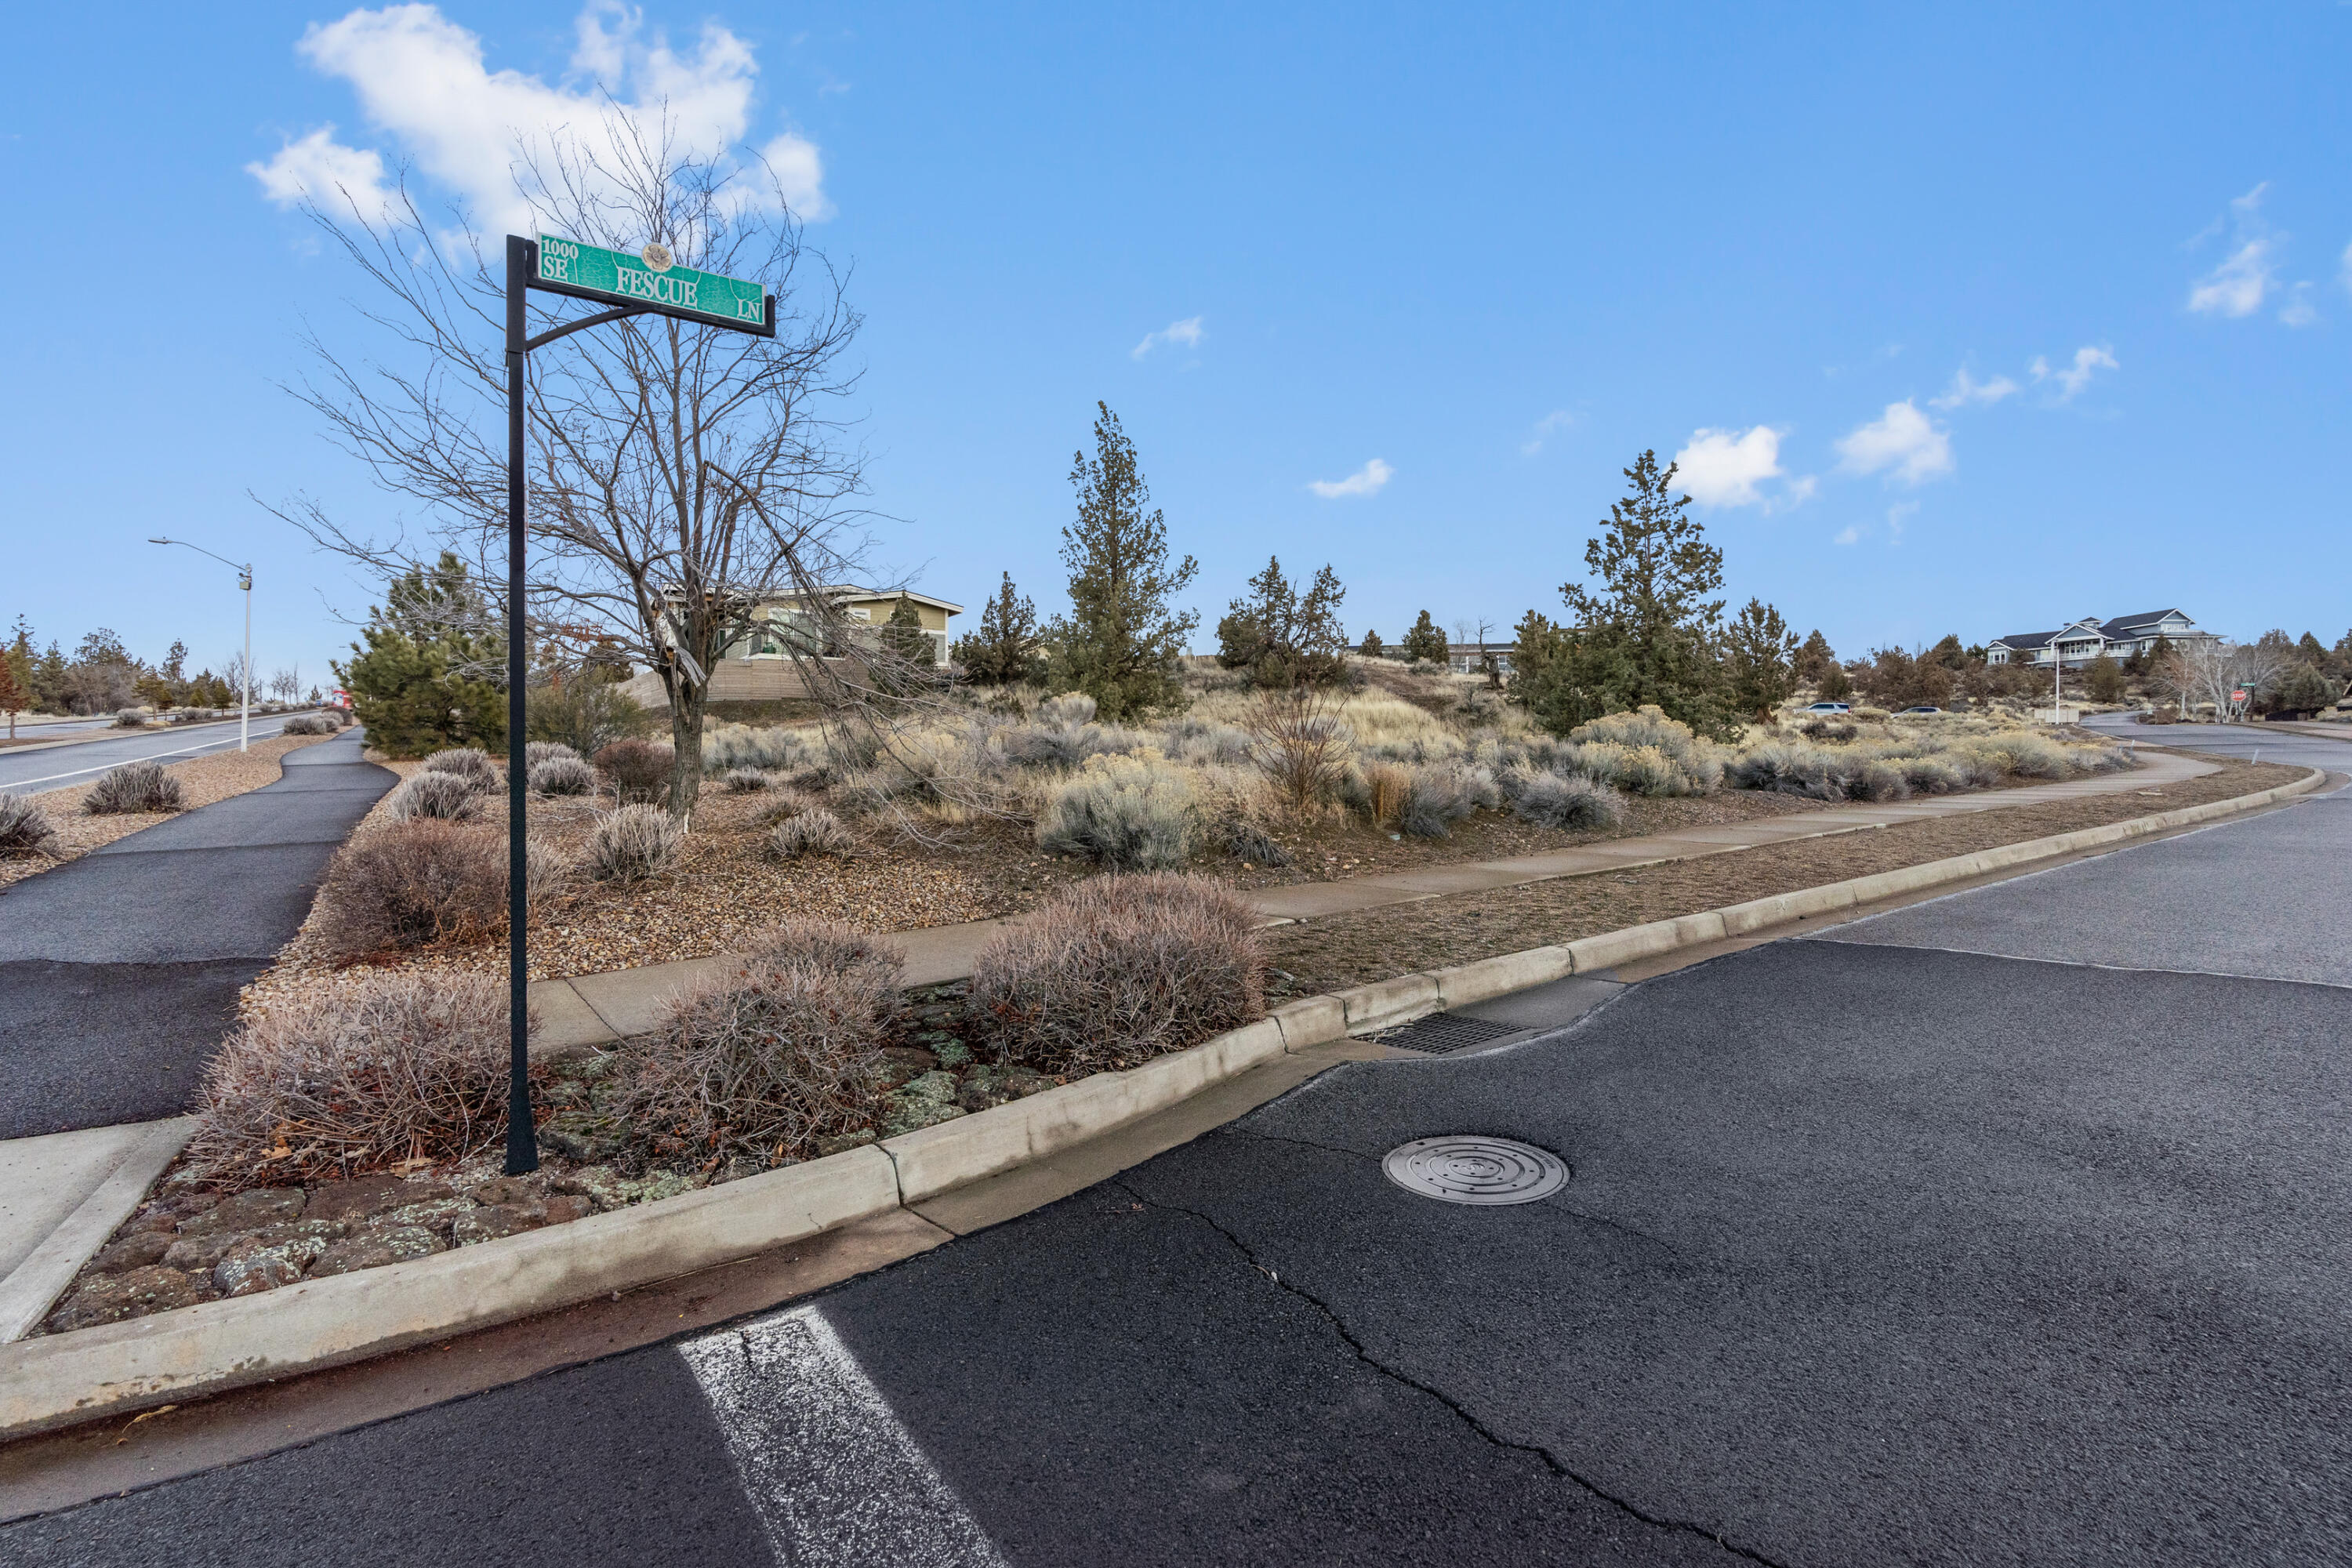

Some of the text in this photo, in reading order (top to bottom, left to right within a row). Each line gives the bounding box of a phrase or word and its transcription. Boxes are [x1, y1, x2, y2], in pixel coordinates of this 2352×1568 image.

[543, 238, 579, 260] 1000
[543, 256, 568, 280] SE
[616, 267, 763, 322] FESCUE LN
